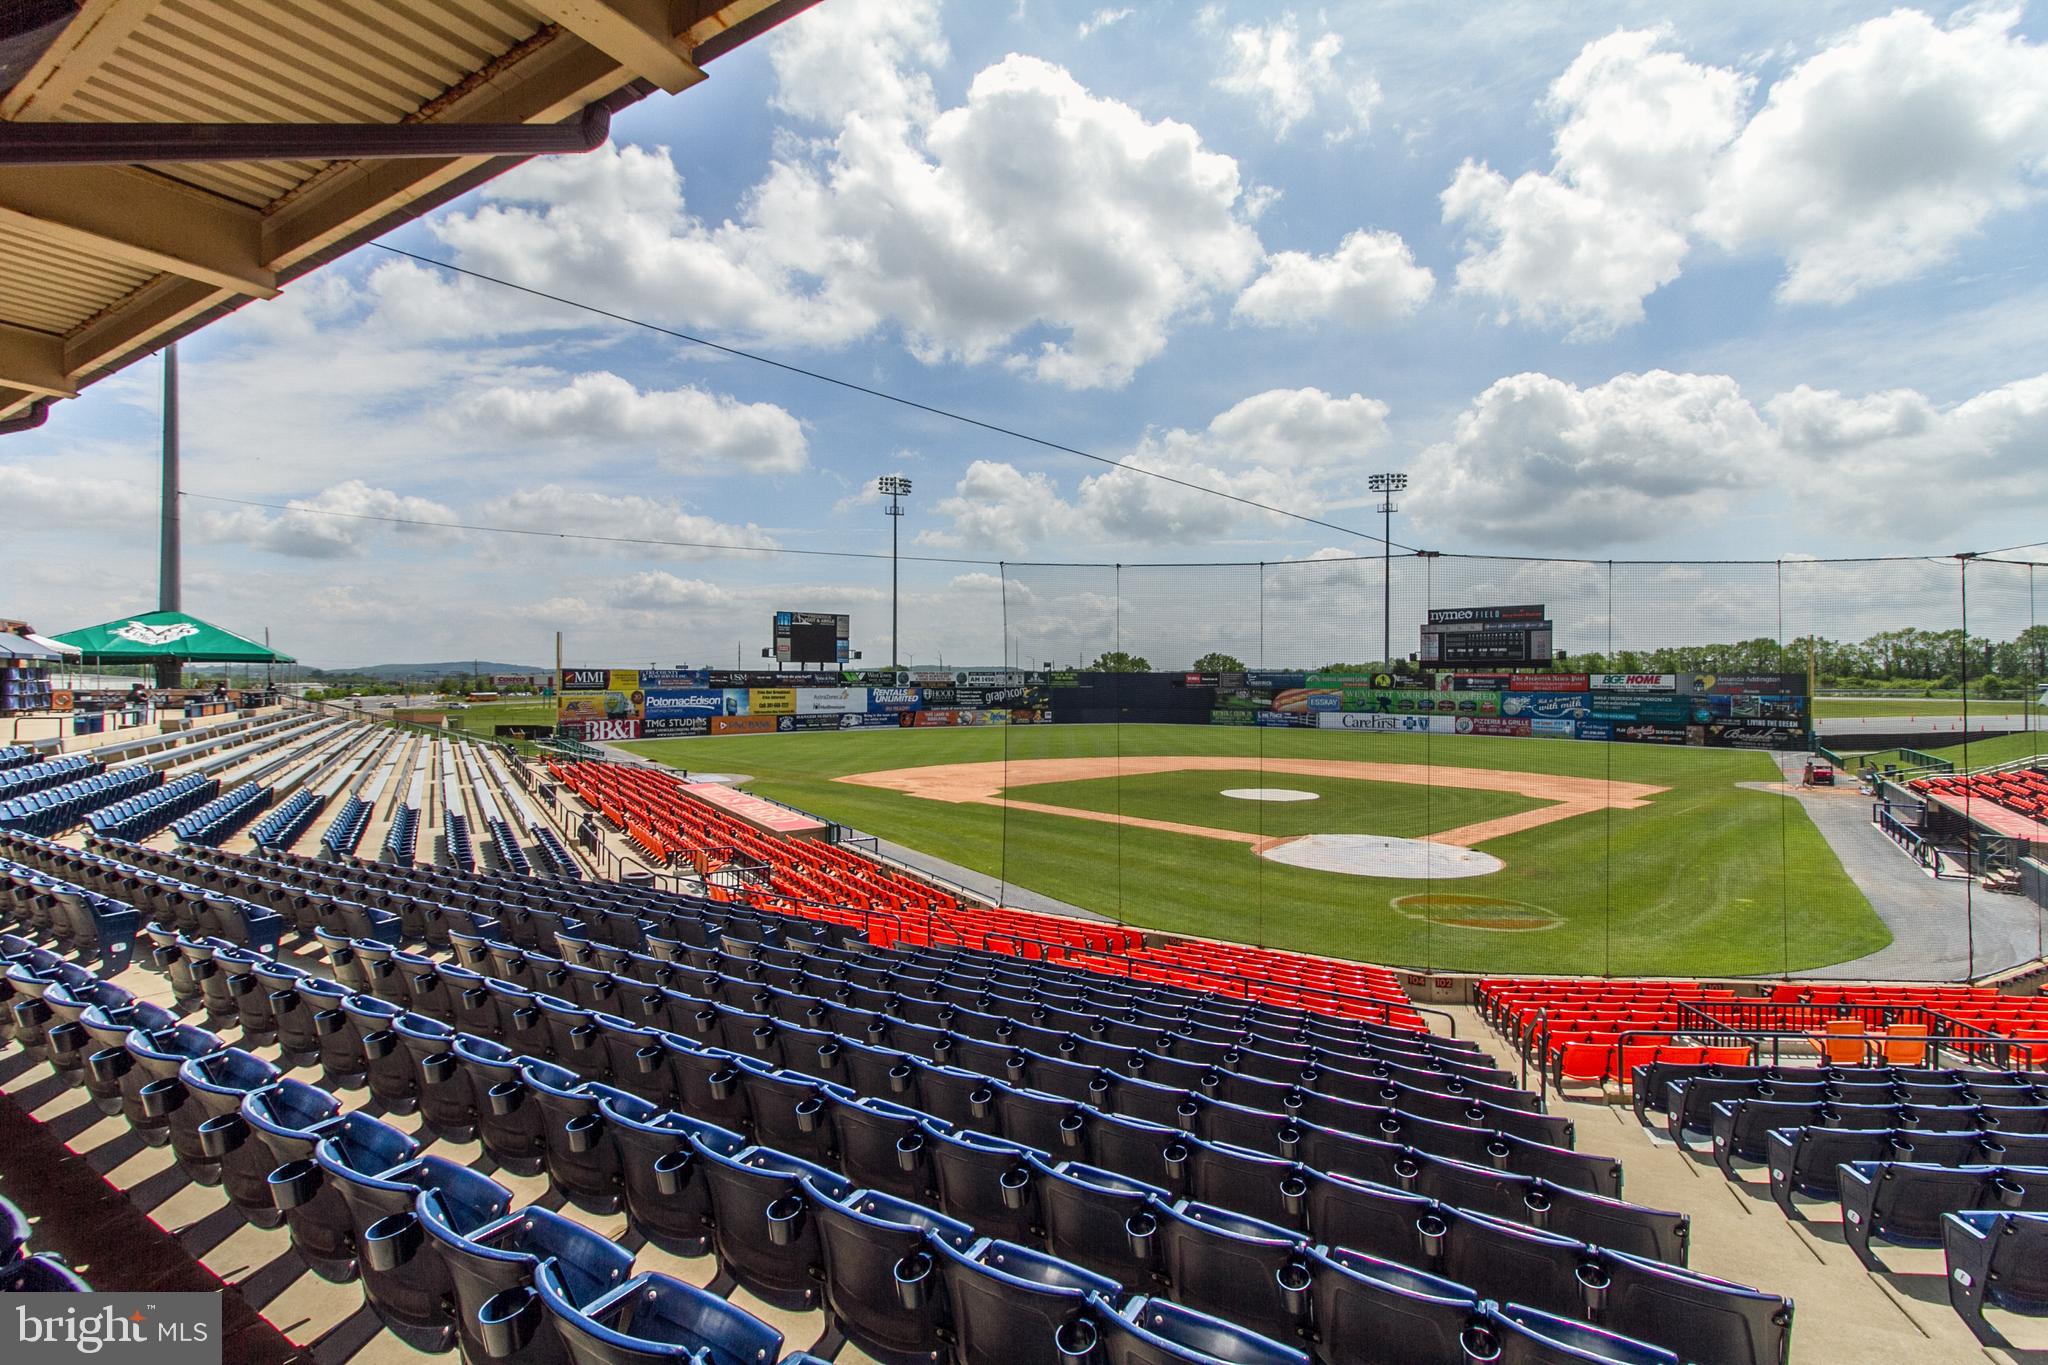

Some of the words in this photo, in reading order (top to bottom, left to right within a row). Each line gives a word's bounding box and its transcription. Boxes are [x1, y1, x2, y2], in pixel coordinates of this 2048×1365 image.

[1430, 611, 1473, 622] nymeo
[1476, 610, 1500, 618] FIELD
[576, 672, 604, 682] MMI
[1602, 676, 1625, 684] BGE
[1626, 676, 1662, 684] HOME
[873, 688, 908, 696] RENTALS
[646, 696, 720, 706] PotomacEdison
[875, 695, 918, 703] UNLIMITED
[1538, 702, 1558, 711] with
[1560, 700, 1582, 708] milk
[645, 720, 666, 728] TMG
[669, 718, 707, 727] STUDIS
[1342, 714, 1400, 729] CareFirst
[584, 720, 640, 740] BB&T
[1409, 976, 1424, 985] 104
[1436, 978, 1452, 987] 102
